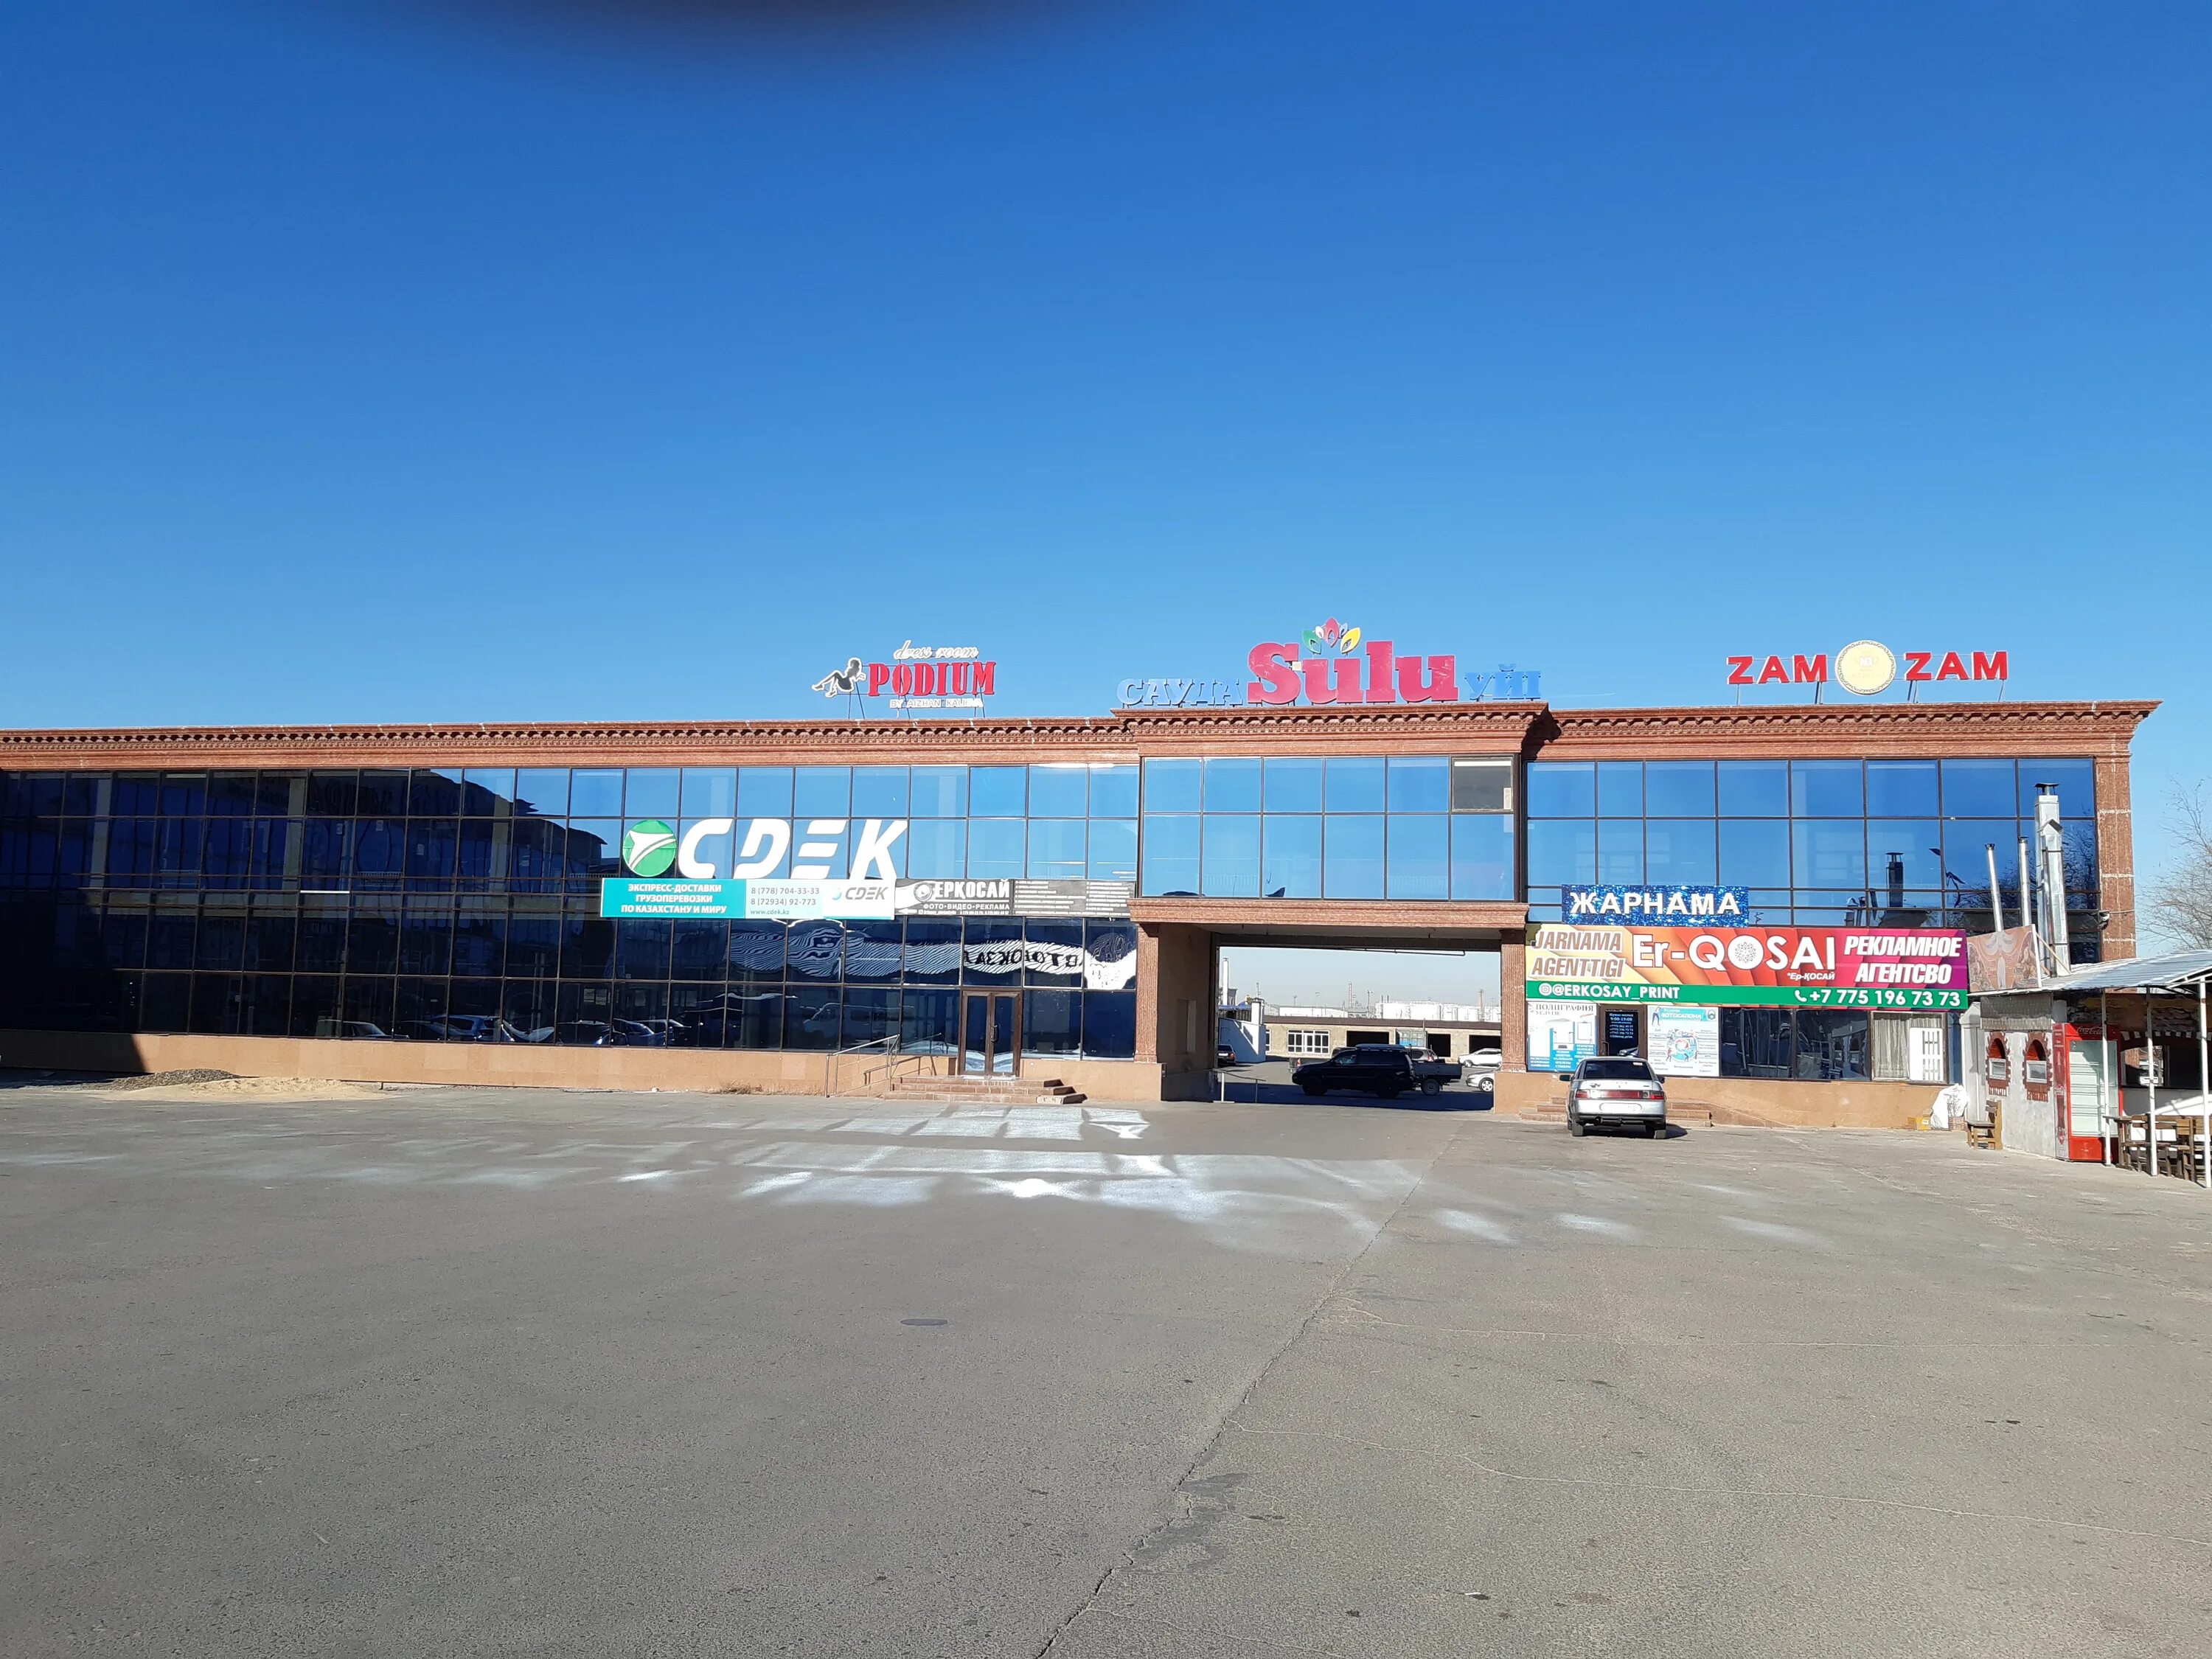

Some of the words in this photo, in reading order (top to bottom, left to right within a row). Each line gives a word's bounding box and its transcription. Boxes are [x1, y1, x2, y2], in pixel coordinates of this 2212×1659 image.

[893, 639, 932, 660] dress
[936, 646, 979, 659] room
[1726, 653, 1828, 685] ZAM
[1904, 650, 2008, 681] ZAM
[868, 661, 996, 697] PODIUM
[1116, 678, 1244, 706] САУДА
[890, 698, 903, 709] BY
[906, 698, 941, 708] AIZHAN
[677, 818, 908, 880] CDEK
[627, 883, 723, 894] ЭКСПРЕСС-ДОСТАВКИ
[635, 894, 714, 903] ГРУЗОПЕРЕВОЗКИ
[751, 887, 757, 895] 8
[757, 887, 778, 896] (778)
[779, 887, 820, 895] 704-33-33
[845, 886, 889, 900] CDEK
[620, 904, 635, 914] ПО
[636, 904, 692, 914] КАЗАХСТАНУ
[693, 905, 700, 914] И
[701, 905, 728, 914] МИРУ
[757, 898, 787, 906] (72934)
[789, 898, 816, 906] 92-773
[1569, 891, 1741, 916] ЖАРНАМА
[1534, 931, 1622, 952] JARNAMA
[1632, 933, 1835, 971] Er-QOSAI
[1844, 935, 1963, 957] РЕКЛАМНОЕ
[1531, 957, 1625, 978] AGENTTIGI
[1854, 963, 1952, 984] АГЕНТСВО
[1536, 1004, 1593, 1012] ПОЛИГРАФИЯ
[1810, 989, 1832, 1004] +7
[1837, 990, 1869, 1004] 775
[1875, 990, 1906, 1005] 196
[1911, 990, 1933, 1006] 73
[1939, 991, 1961, 1006] 73
